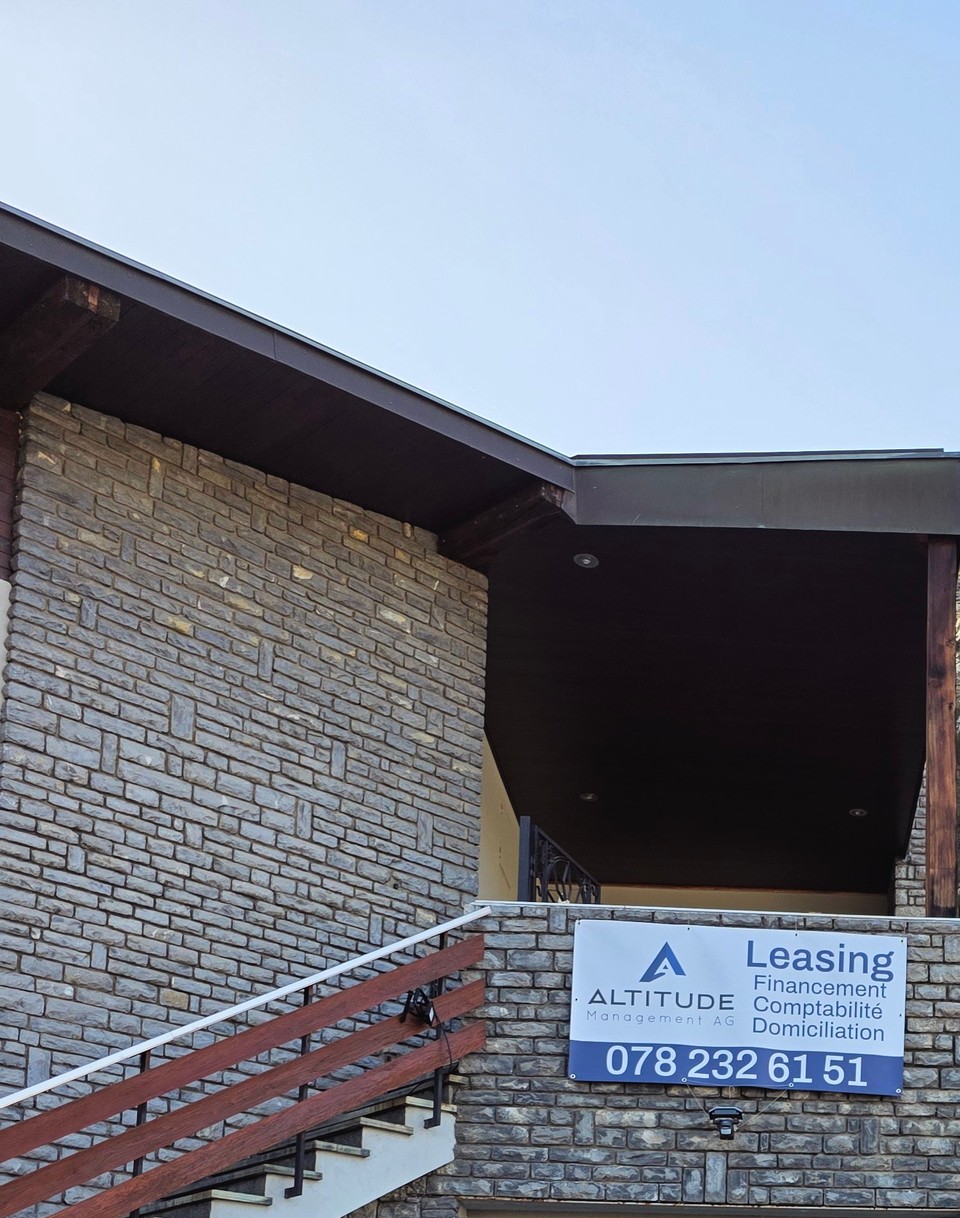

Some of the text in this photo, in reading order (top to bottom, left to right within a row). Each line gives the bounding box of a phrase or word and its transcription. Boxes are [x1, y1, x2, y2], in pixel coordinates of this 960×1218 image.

[747, 940, 895, 982] Leasing
[754, 974, 887, 999] Financement
[587, 988, 735, 1011] ALTITUDE
[753, 996, 883, 1020] Comptabilité
[586, 1010, 735, 1027] Management AG
[752, 1017, 885, 1041] Domiciliation
[606, 1045, 868, 1087] 078 232 61 51
